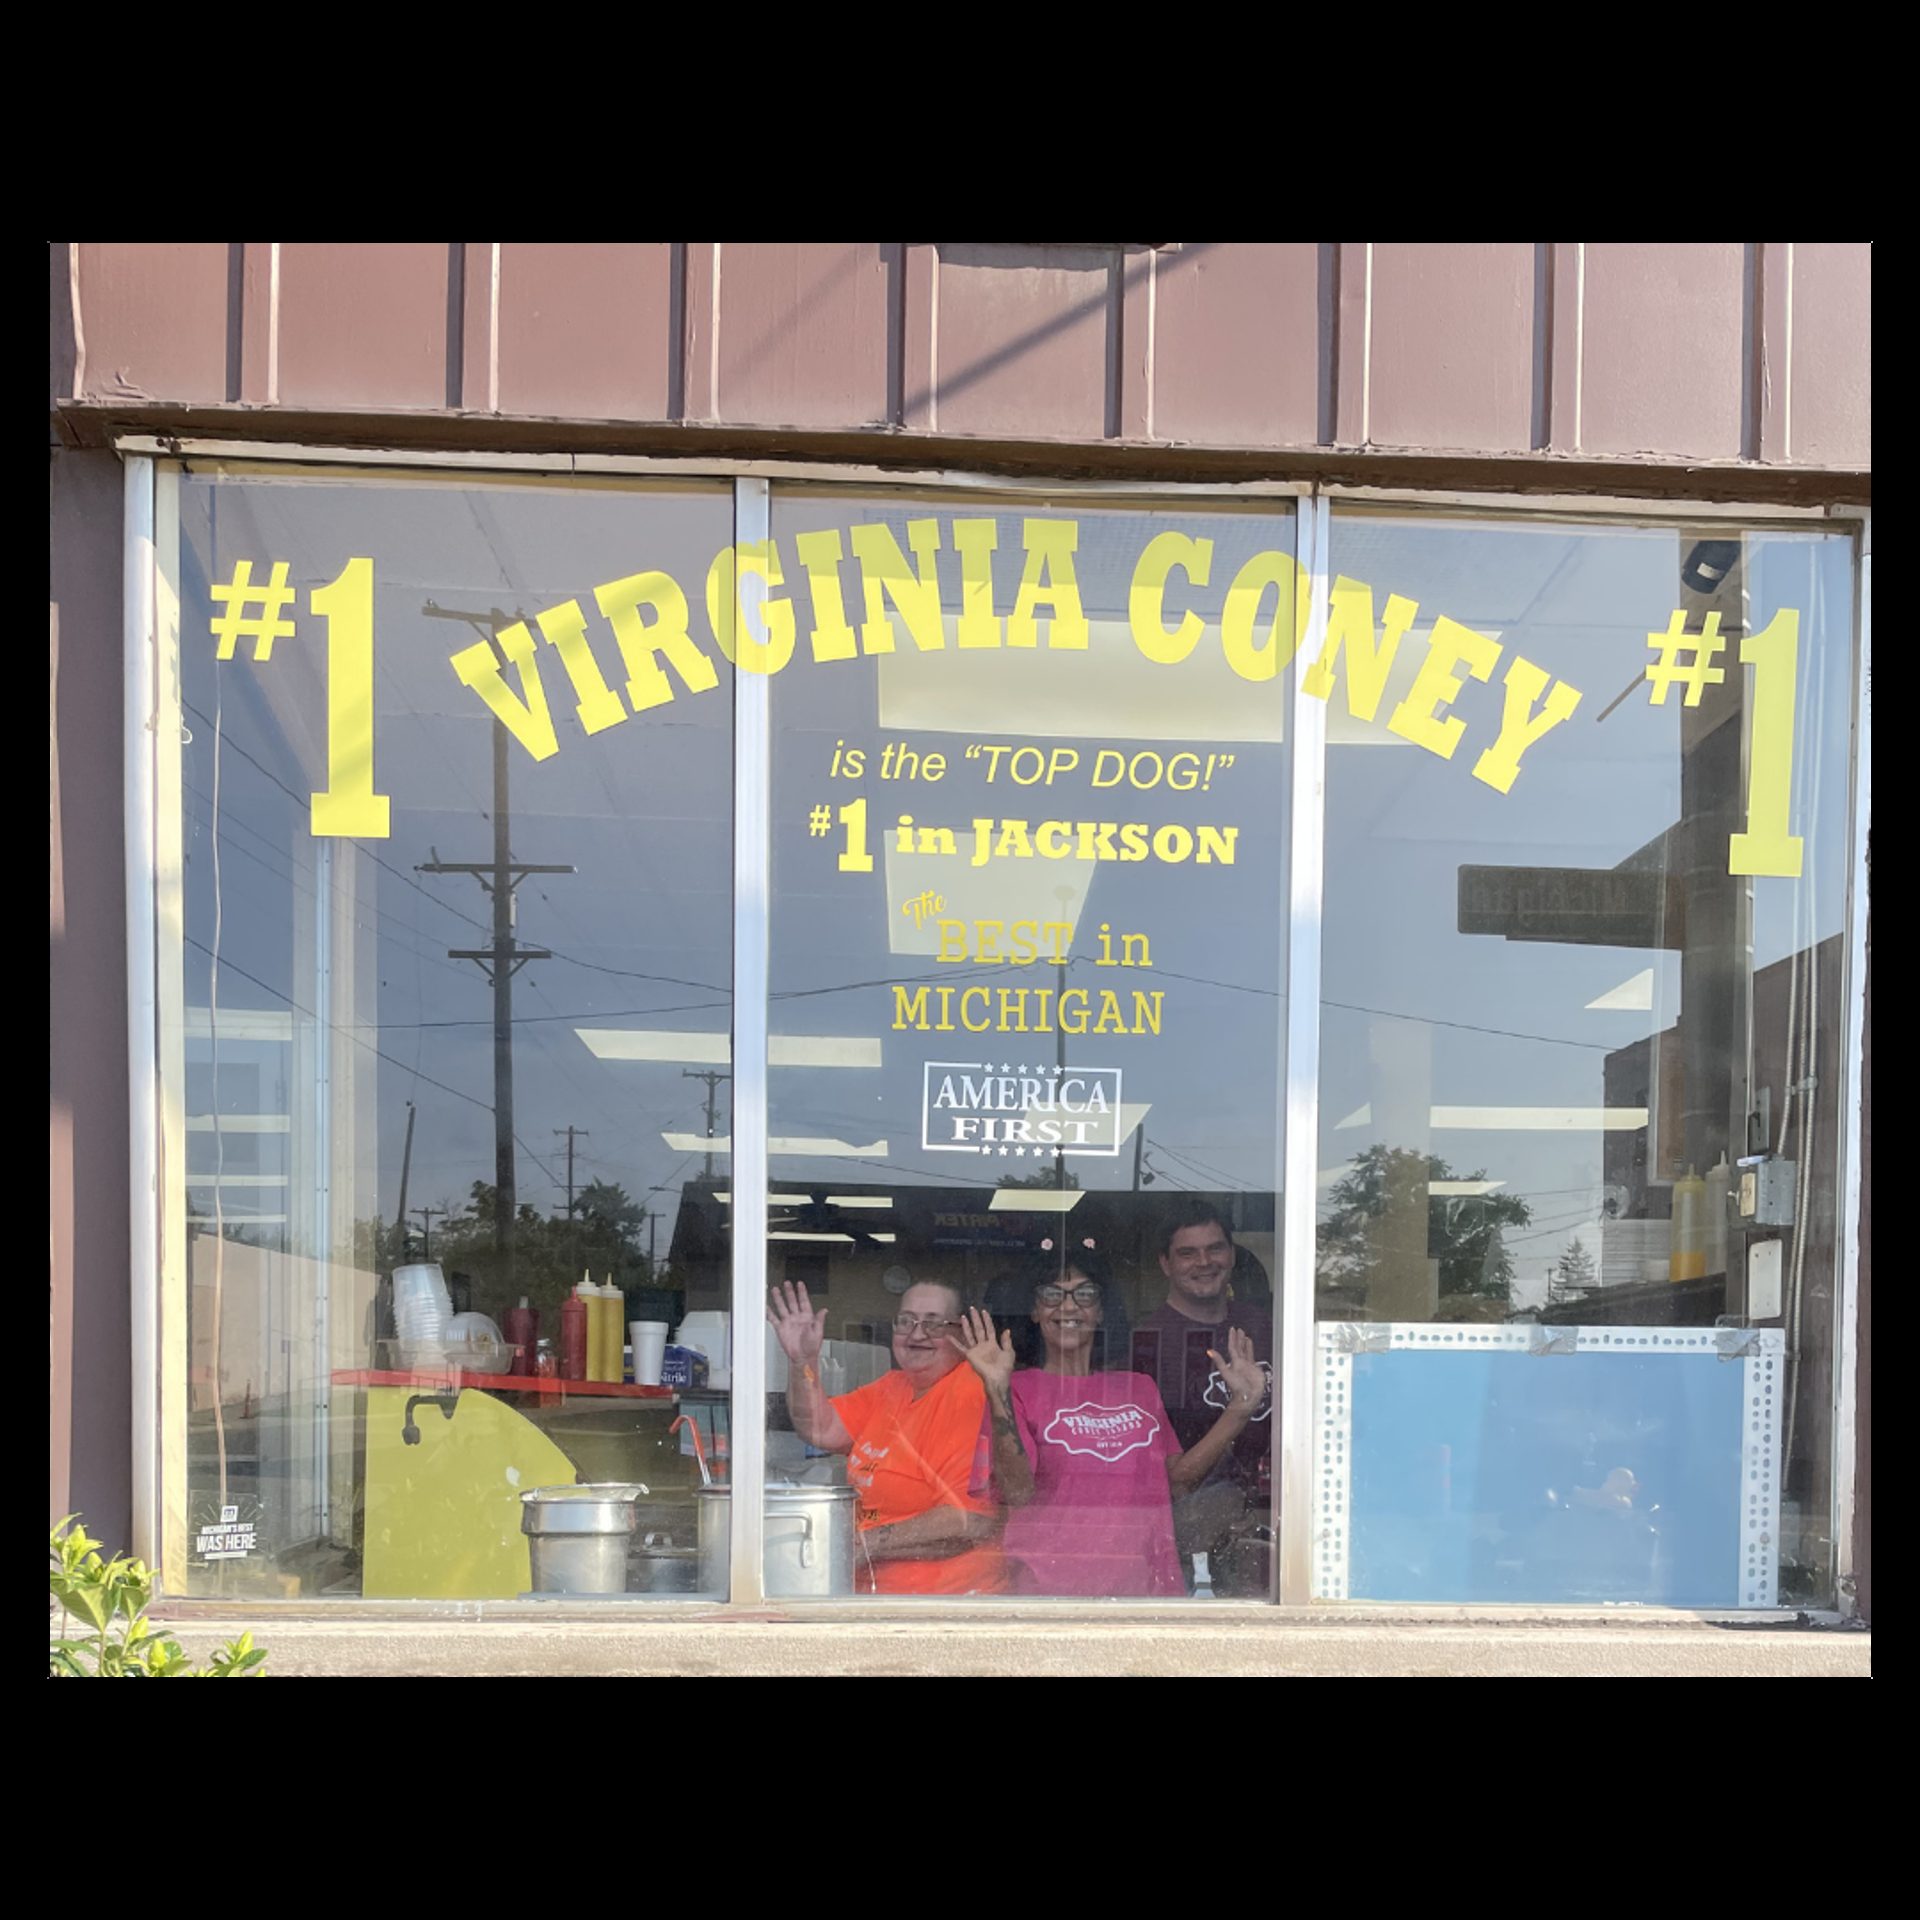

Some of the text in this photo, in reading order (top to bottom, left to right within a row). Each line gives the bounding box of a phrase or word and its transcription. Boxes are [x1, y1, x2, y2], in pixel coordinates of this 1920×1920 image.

[450, 518, 1582, 795] VIRGINIA CONEY
[210, 557, 391, 839] #1
[830, 740, 1236, 791] is the “TOP DOG!”
[1645, 608, 1803, 877] #1
[809, 797, 1239, 873] #1 in JACKSON
[902, 889, 946, 930] The
[936, 918, 1153, 967] BEST in
[891, 985, 1165, 1036] MICHIGAN
[932, 1074, 1112, 1115] AMERICA
[950, 1116, 1099, 1145] FIRST
[1063, 1410, 1143, 1428] VIRGINIA
[197, 1533, 257, 1552] WAS HERE
